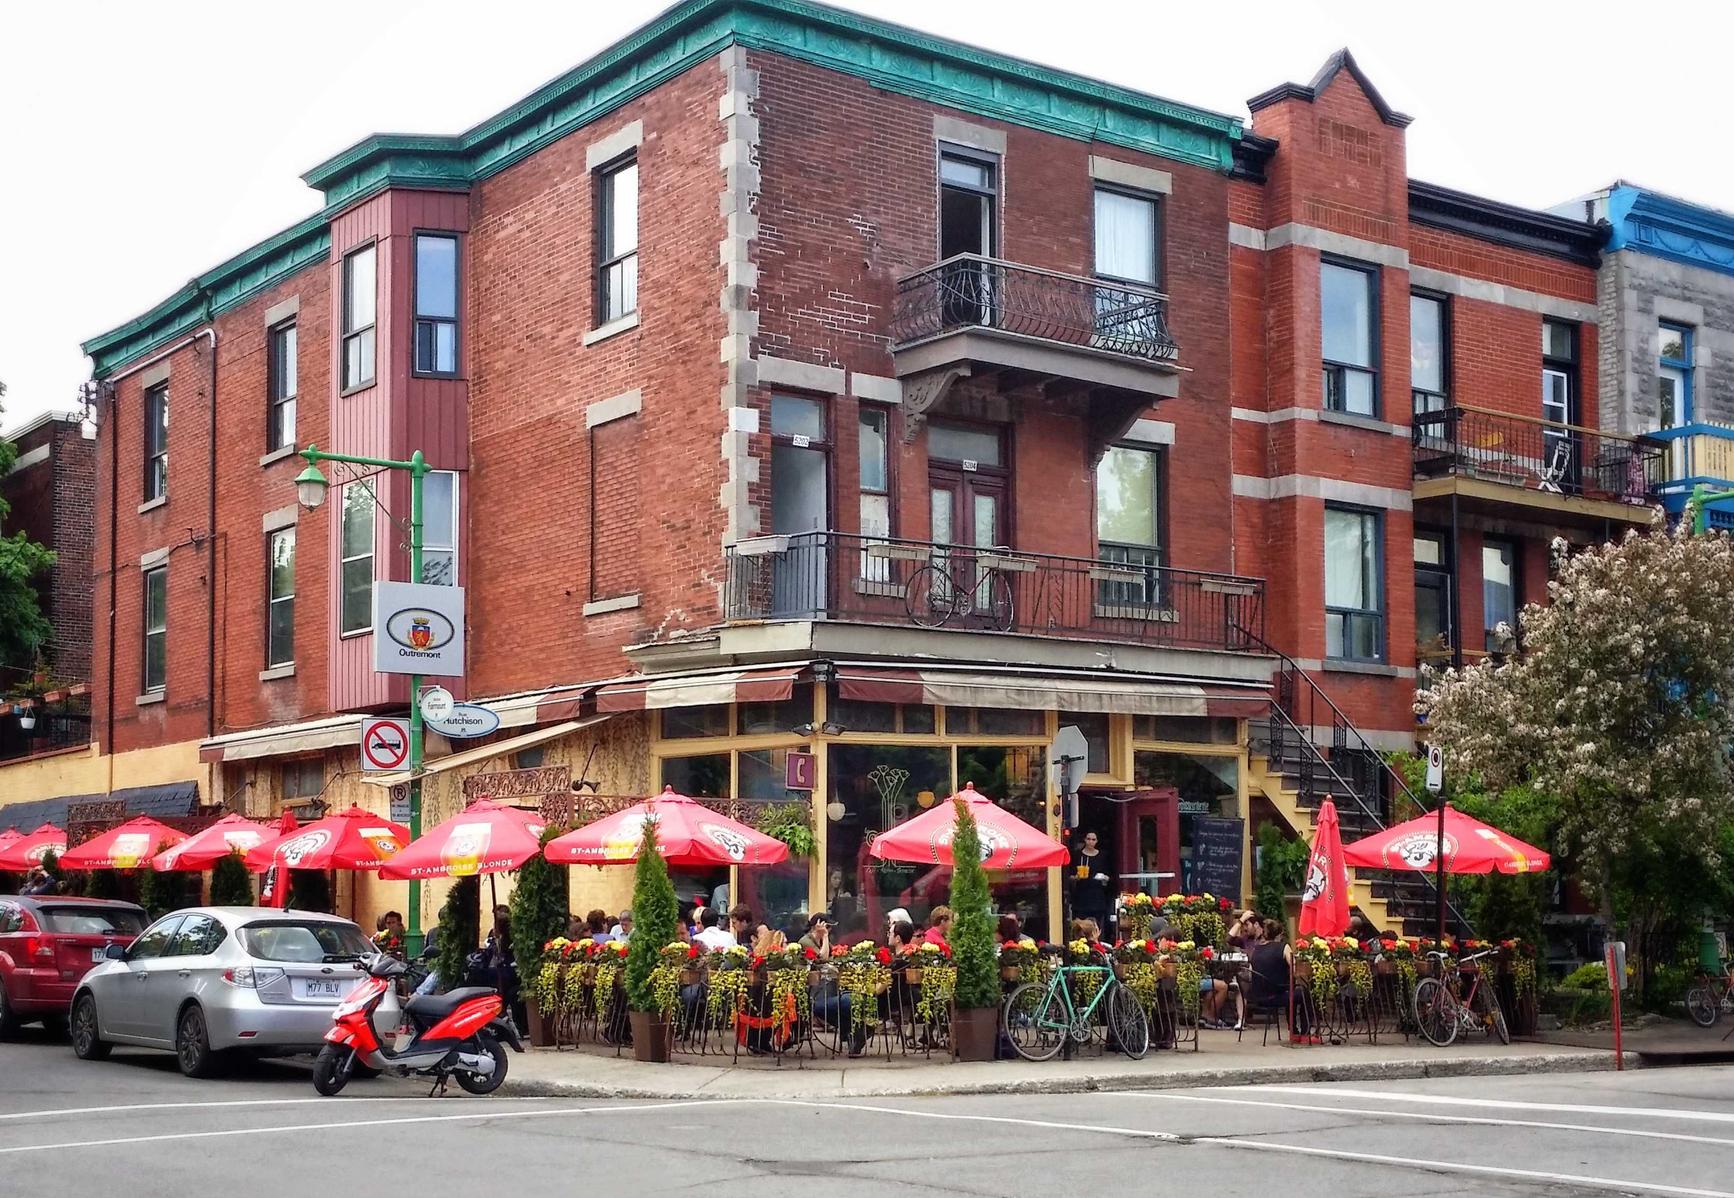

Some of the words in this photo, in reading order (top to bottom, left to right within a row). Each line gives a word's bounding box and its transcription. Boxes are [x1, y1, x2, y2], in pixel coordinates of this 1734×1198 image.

[794, 435, 809, 446] 5202
[399, 649, 441, 659] Outremont
[410, 863, 474, 876] ST-AMBROISE
[477, 859, 513, 869] BLONDE
[308, 983, 321, 993] M77
[325, 983, 339, 993] BLV
